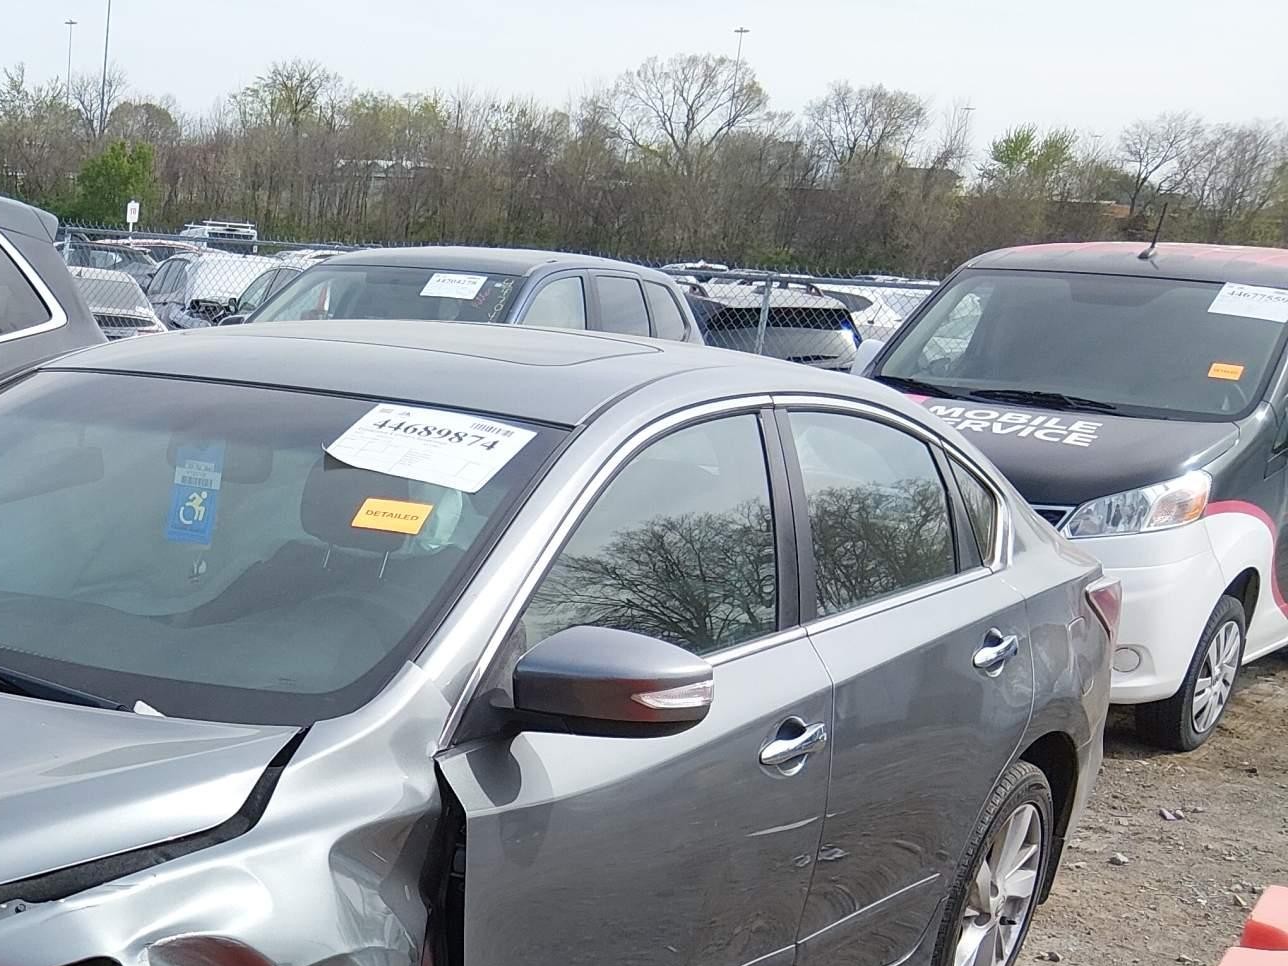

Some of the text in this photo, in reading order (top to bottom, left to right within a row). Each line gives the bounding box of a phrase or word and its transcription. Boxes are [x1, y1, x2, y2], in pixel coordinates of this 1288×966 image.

[928, 405, 1104, 434] MOBILE
[373, 418, 500, 451] 44689874
[365, 509, 420, 521] DETAILED
